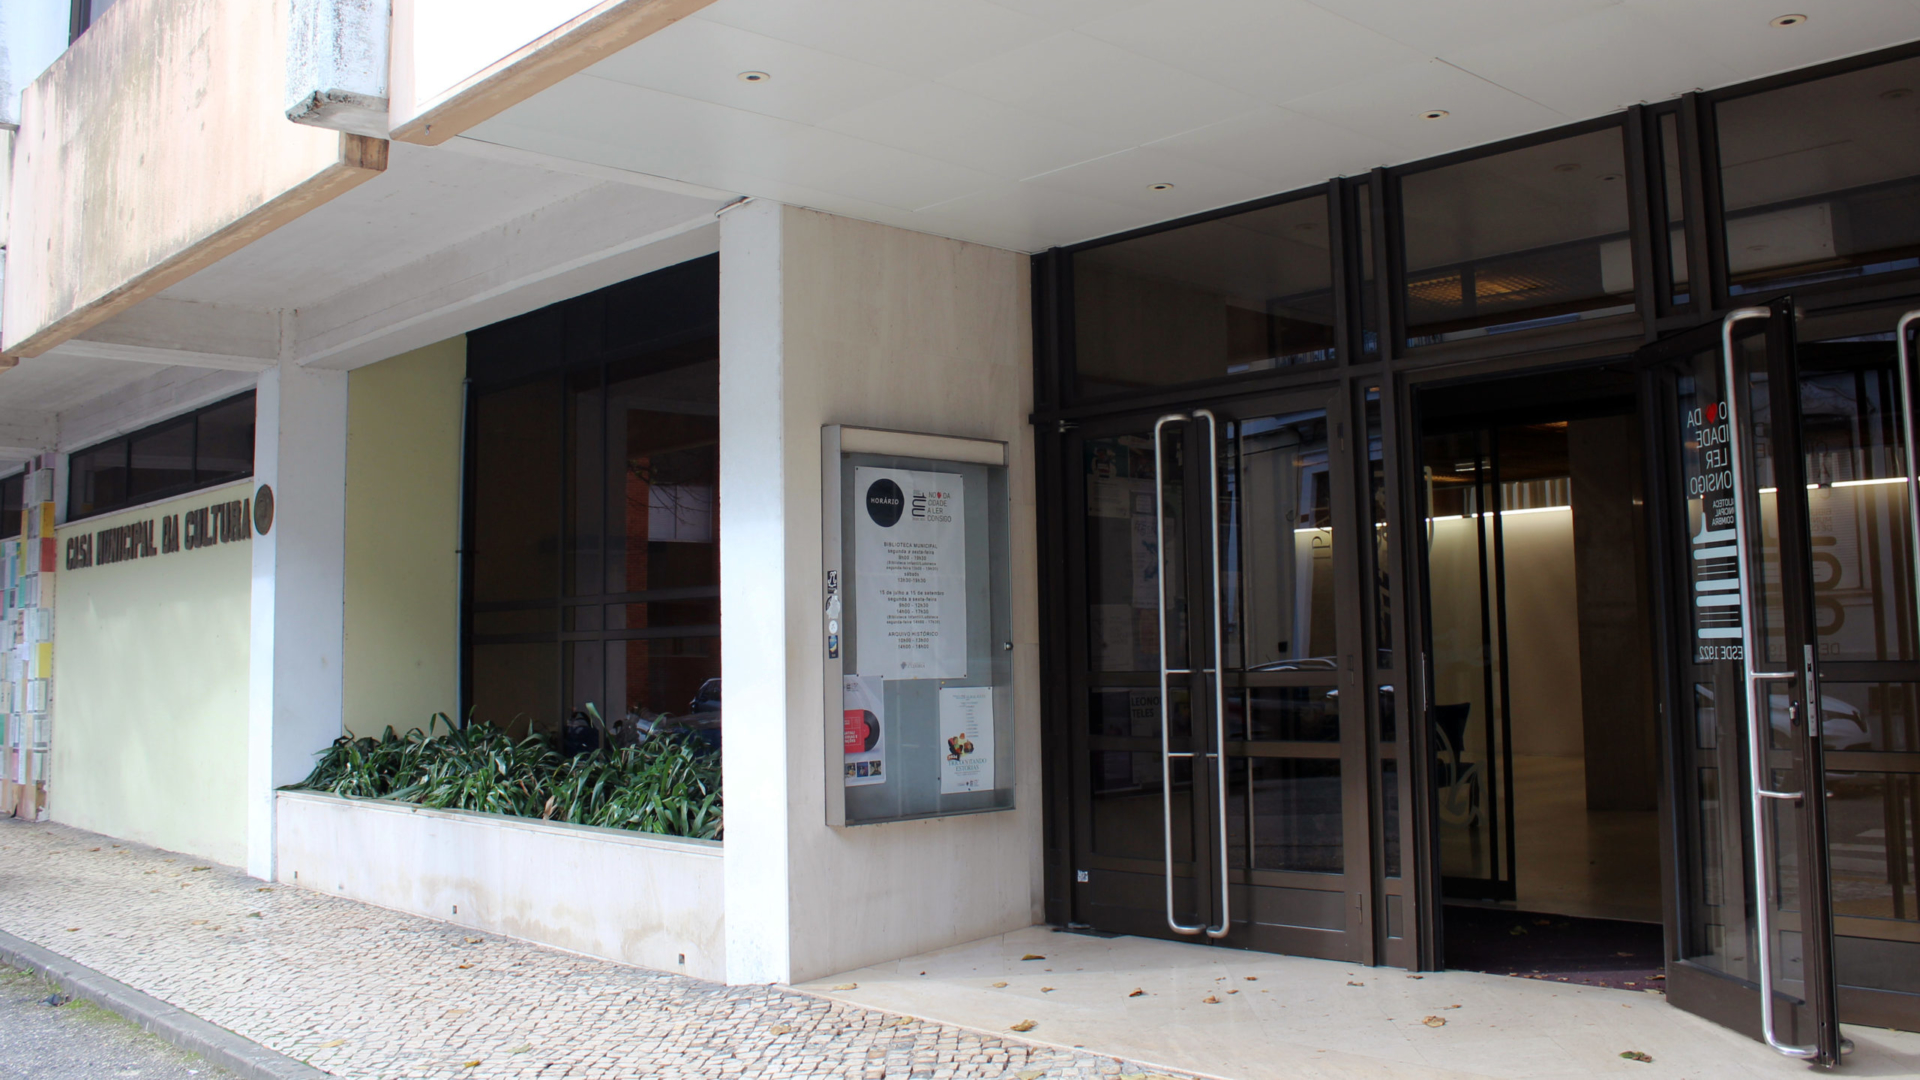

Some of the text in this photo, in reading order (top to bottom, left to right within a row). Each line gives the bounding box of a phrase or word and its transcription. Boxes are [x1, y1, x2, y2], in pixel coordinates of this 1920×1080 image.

[870, 496, 900, 506] HORÁRIO
[928, 500, 948, 508] CIDADE
[66, 498, 252, 571] CASA MUNICIPAL DA CULTURA
[1131, 696, 1161, 707] LEONO
[1132, 708, 1154, 718] TELES
